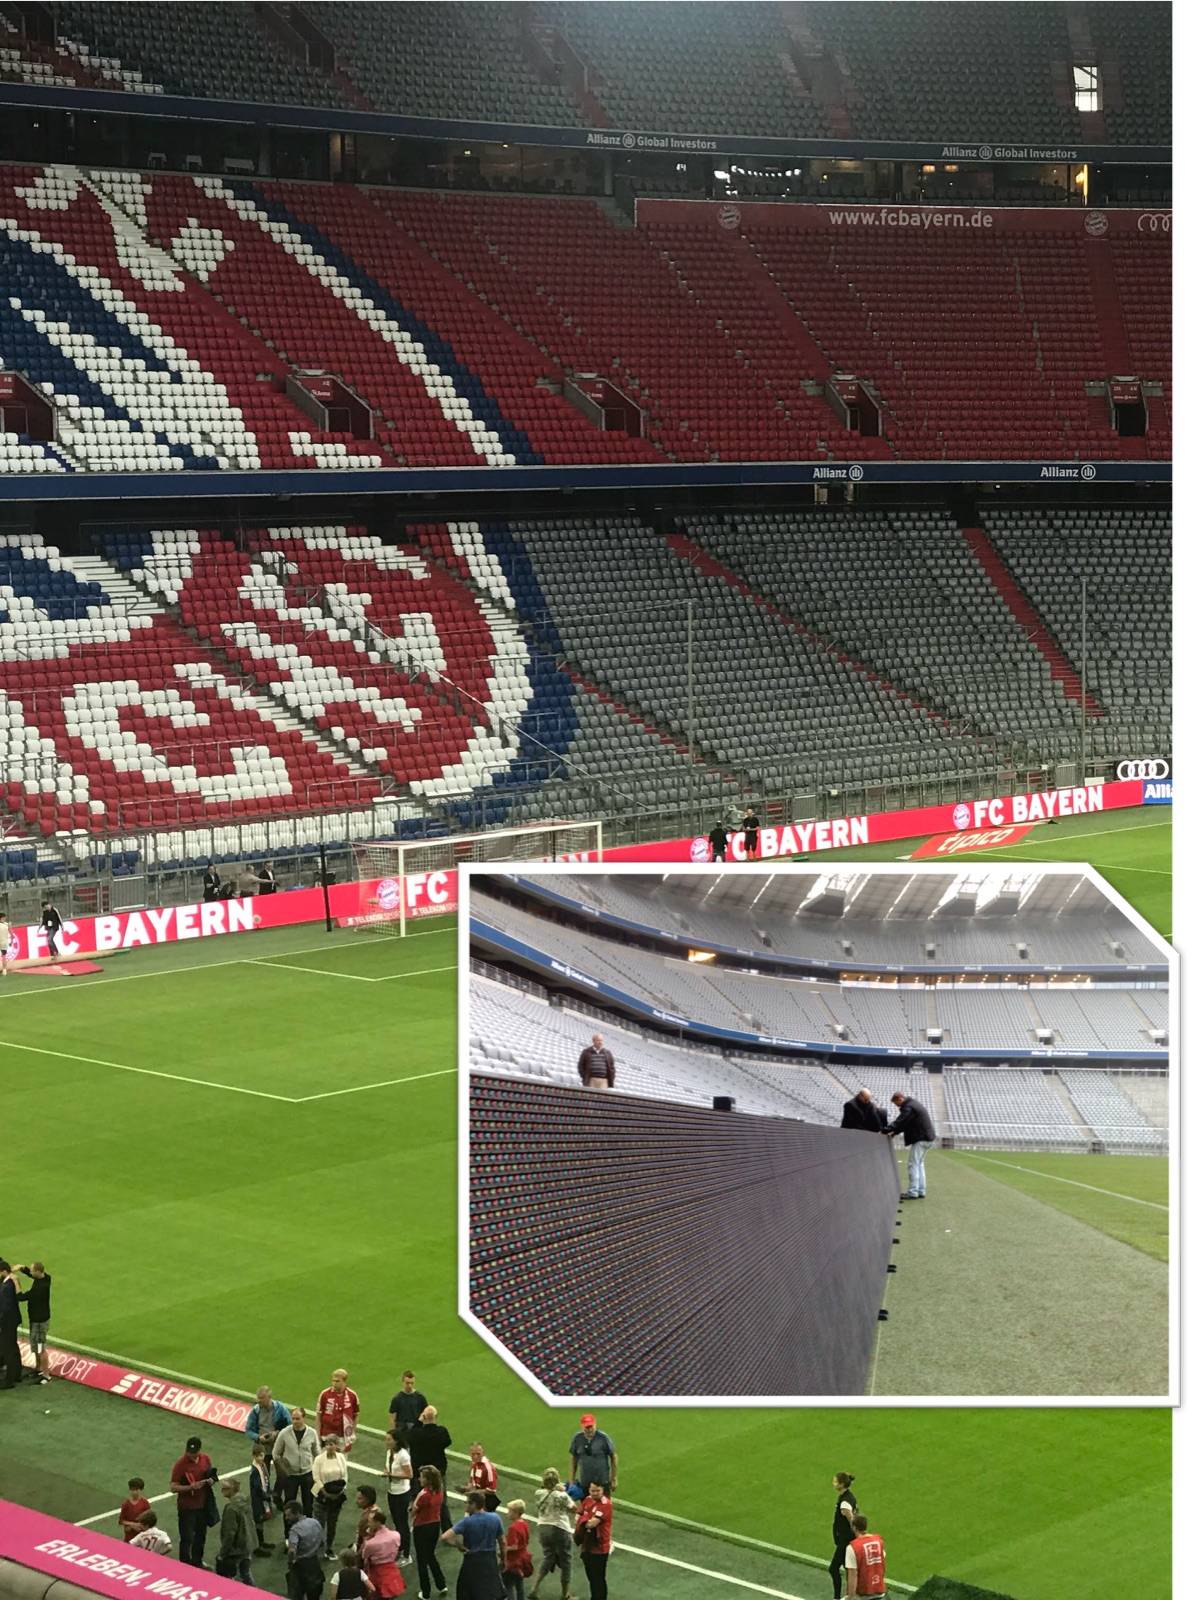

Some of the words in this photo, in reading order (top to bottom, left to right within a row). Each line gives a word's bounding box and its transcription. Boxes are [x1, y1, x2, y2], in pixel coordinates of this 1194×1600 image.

[586, 133, 621, 145] Allianz
[637, 136, 669, 148] Global
[671, 138, 717, 149] Investors
[942, 147, 977, 157] Allianz
[994, 147, 1027, 158] Global
[1030, 148, 1077, 159] Investors
[828, 208, 993, 229] www.fcbayern.de
[813, 468, 847, 479] Allianz
[1040, 466, 1079, 478] Allianz
[974, 798, 1004, 828] FC
[1012, 785, 1104, 823] BAYERN
[760, 816, 869, 858] BAYERN
[936, 827, 1015, 853] tipico
[406, 872, 449, 907] FC
[26, 921, 80, 960] FC
[95, 898, 254, 951] BAYERN
[48, 1351, 98, 1381] SPORT
[134, 1379, 215, 1417] TELEKOM
[34, 1539, 152, 1588] ERLEBEN,
[144, 1578, 209, 1600] WAS
